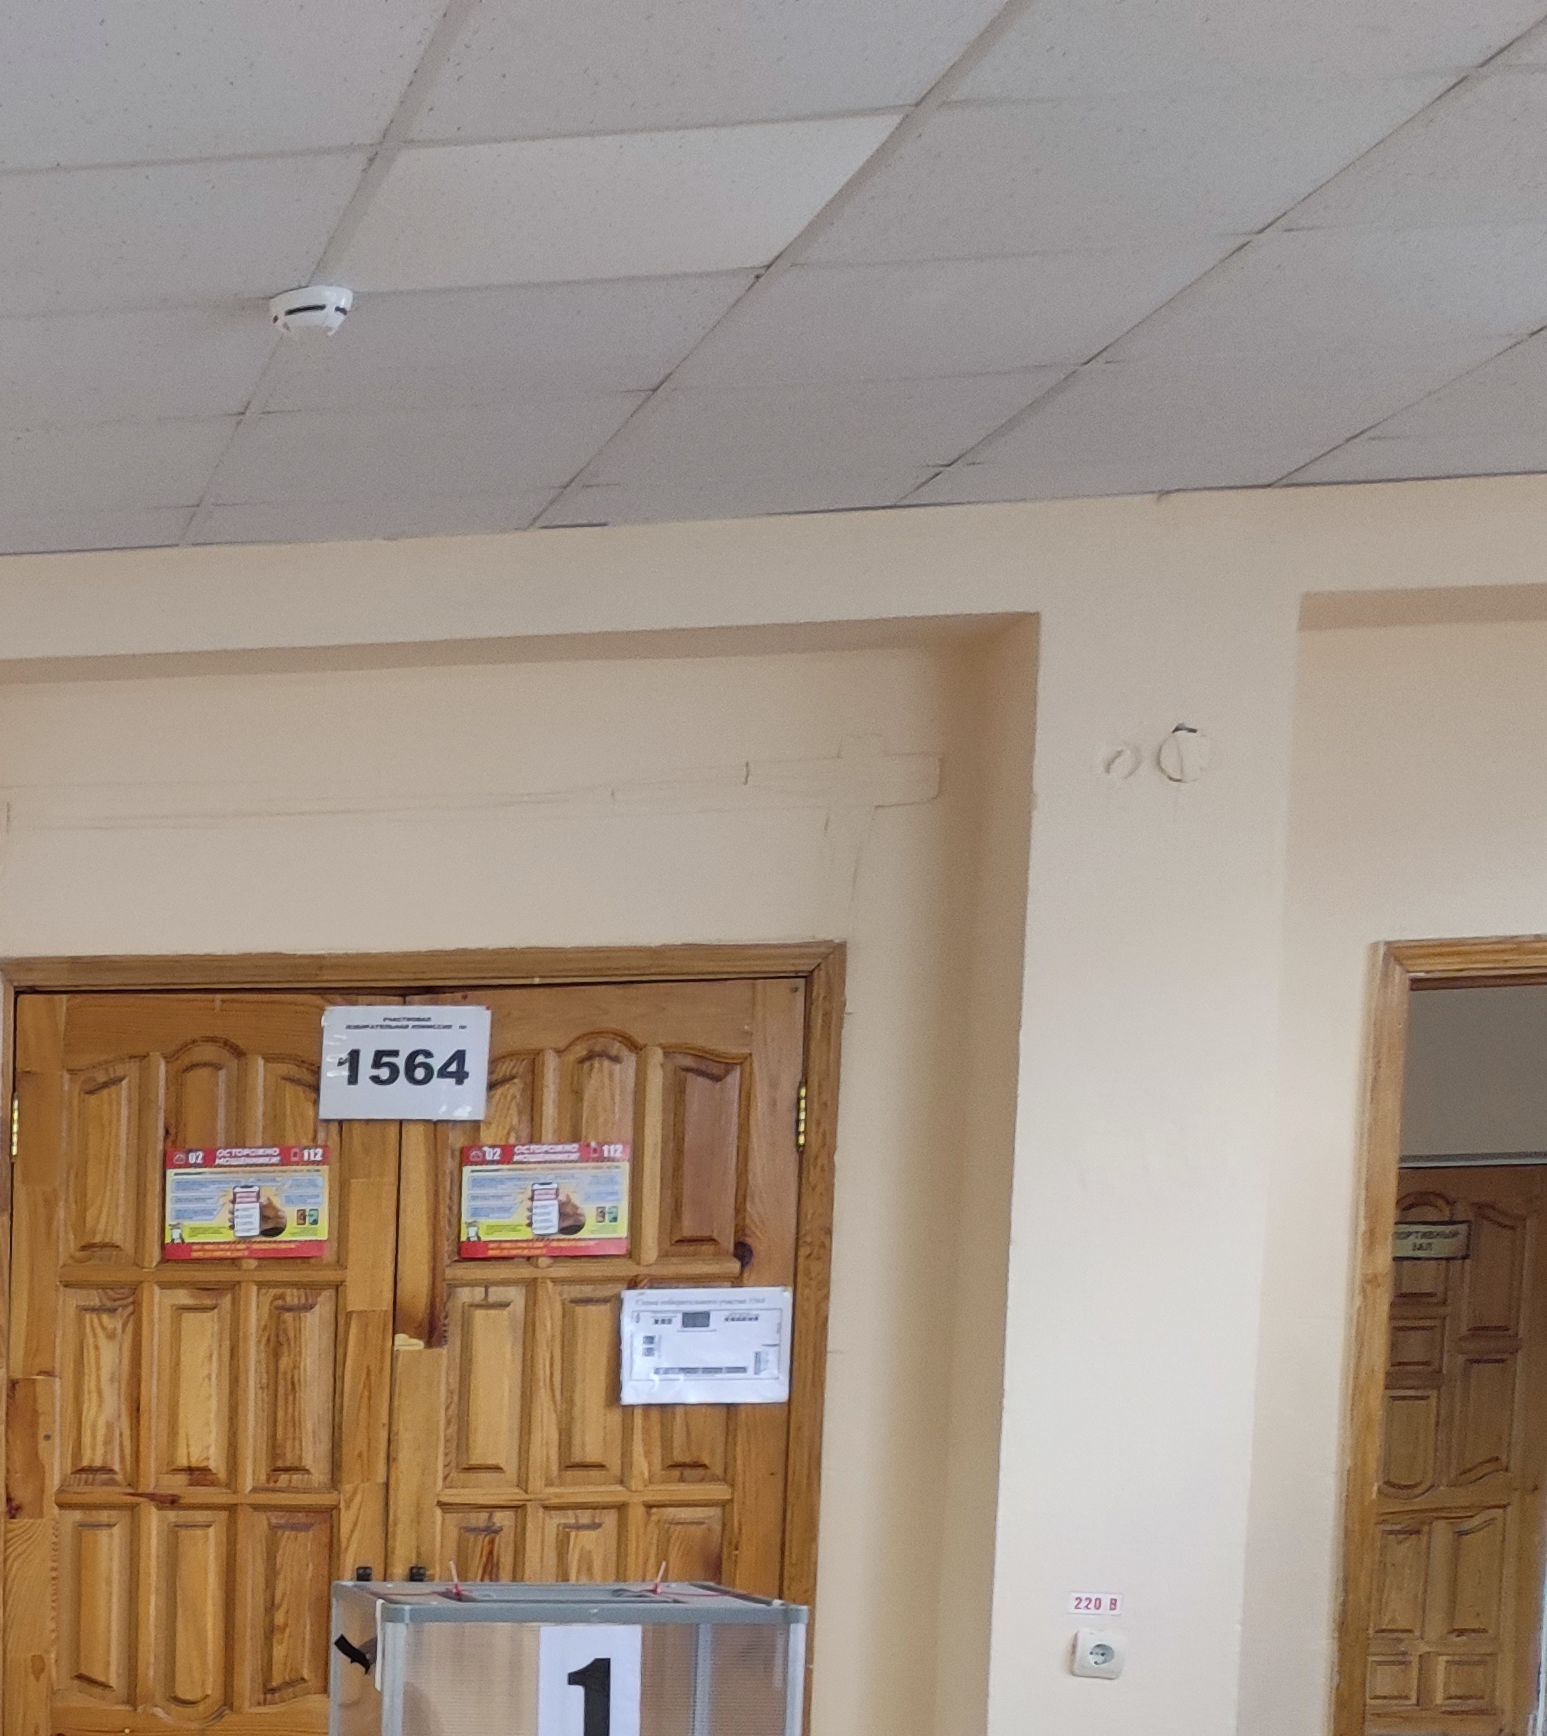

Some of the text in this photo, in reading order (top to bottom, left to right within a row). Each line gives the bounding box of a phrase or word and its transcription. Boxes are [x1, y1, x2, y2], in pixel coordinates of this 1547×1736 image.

[337, 1048, 470, 1086] 1564
[302, 1148, 323, 1161] 112
[602, 1144, 623, 1157] 112
[1074, 1596, 1102, 1610] 220
